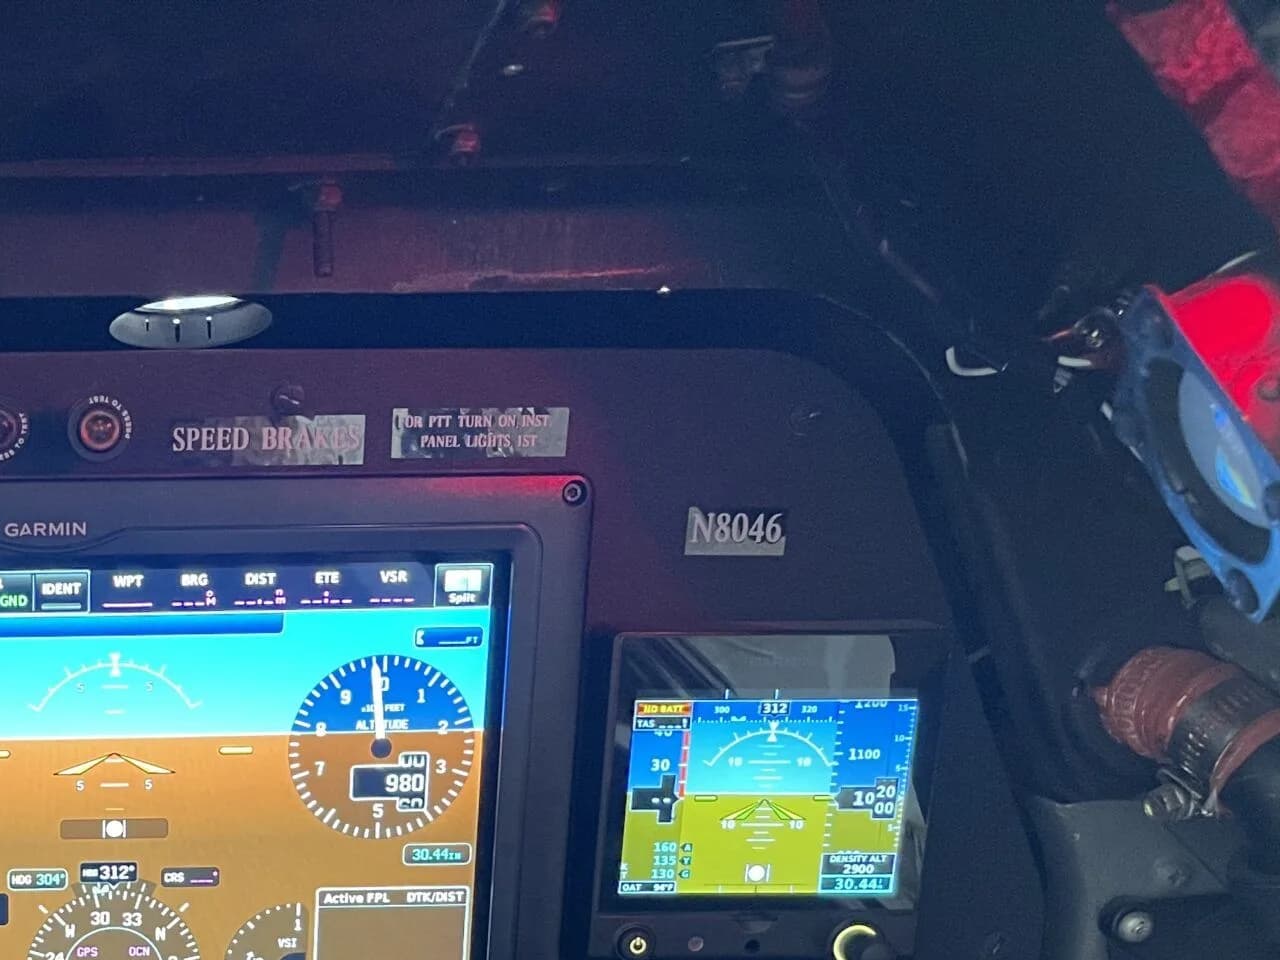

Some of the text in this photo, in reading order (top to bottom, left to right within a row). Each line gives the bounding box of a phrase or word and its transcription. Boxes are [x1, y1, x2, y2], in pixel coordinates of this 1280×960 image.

[429, 415, 492, 428] PTT TURN
[173, 424, 361, 452] SPEED BRAKES
[421, 434, 510, 448] PANEL LIGHTS
[5, 522, 86, 536] GARMIN
[690, 513, 783, 543] N8046
[113, 575, 143, 588] WPT
[182, 574, 208, 586] BRG
[245, 573, 276, 585] DIST
[316, 572, 339, 584] ETE
[380, 571, 407, 583] VSR
[42, 583, 81, 594] IDENT
[0, 594, 28, 608] GND
[763, 703, 787, 713] 312
[848, 749, 880, 760] 1100
[651, 759, 670, 771] 30
[386, 774, 424, 792] 980
[654, 843, 676, 852] 160
[654, 857, 676, 865] 135
[651, 869, 674, 878] 130
[324, 893, 390, 904] Active FPL
[407, 891, 464, 903] DTK/DIST
[91, 912, 109, 927] 30
[123, 913, 142, 927] 33
[77, 946, 97, 958] GPS
